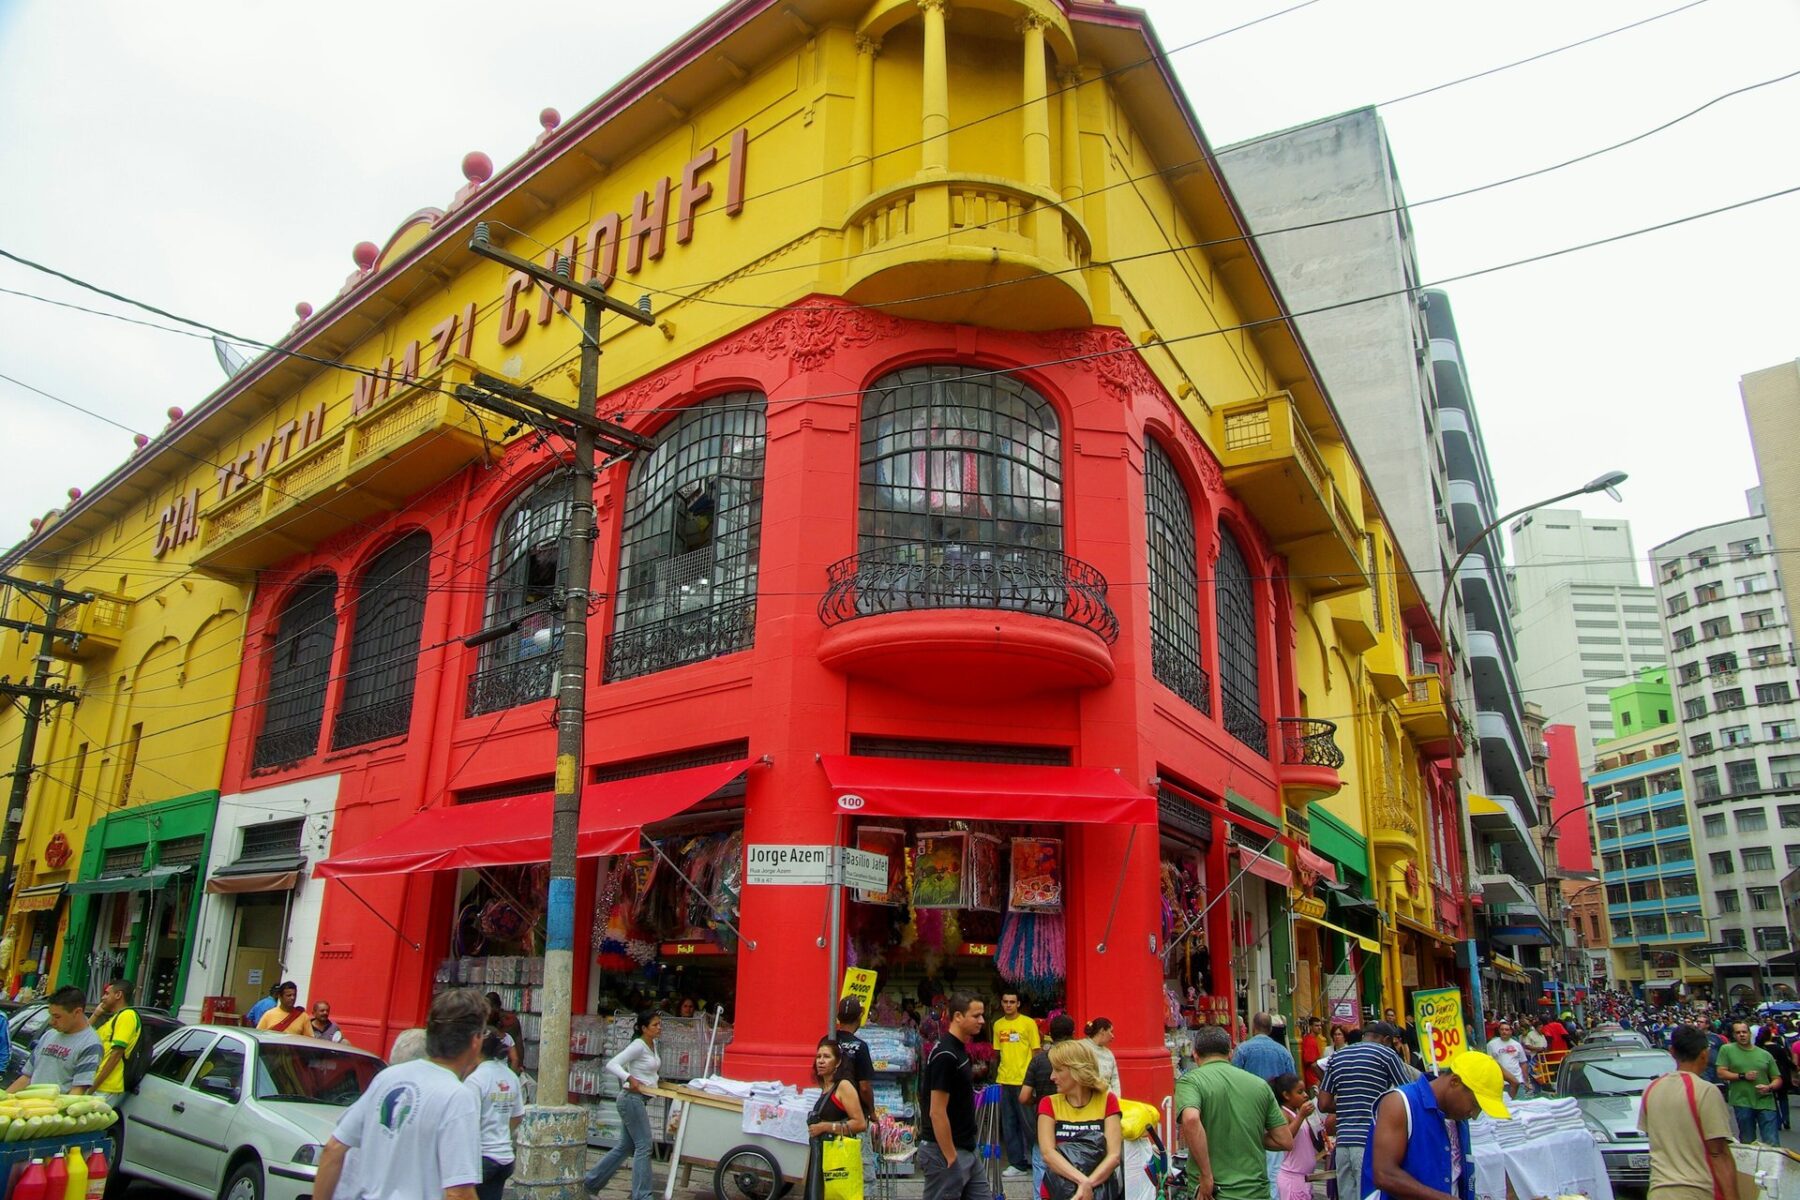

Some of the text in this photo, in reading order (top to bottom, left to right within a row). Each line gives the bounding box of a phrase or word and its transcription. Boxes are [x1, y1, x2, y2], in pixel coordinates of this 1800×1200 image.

[350, 303, 477, 416] NIAZI
[498, 128, 747, 345] CHOHFI
[841, 797, 861, 807] 100
[749, 847, 824, 866] Jorge Azem
[871, 857, 888, 873] Jafet
[856, 973, 867, 982] 10
[1420, 1002, 1435, 1017] 10
